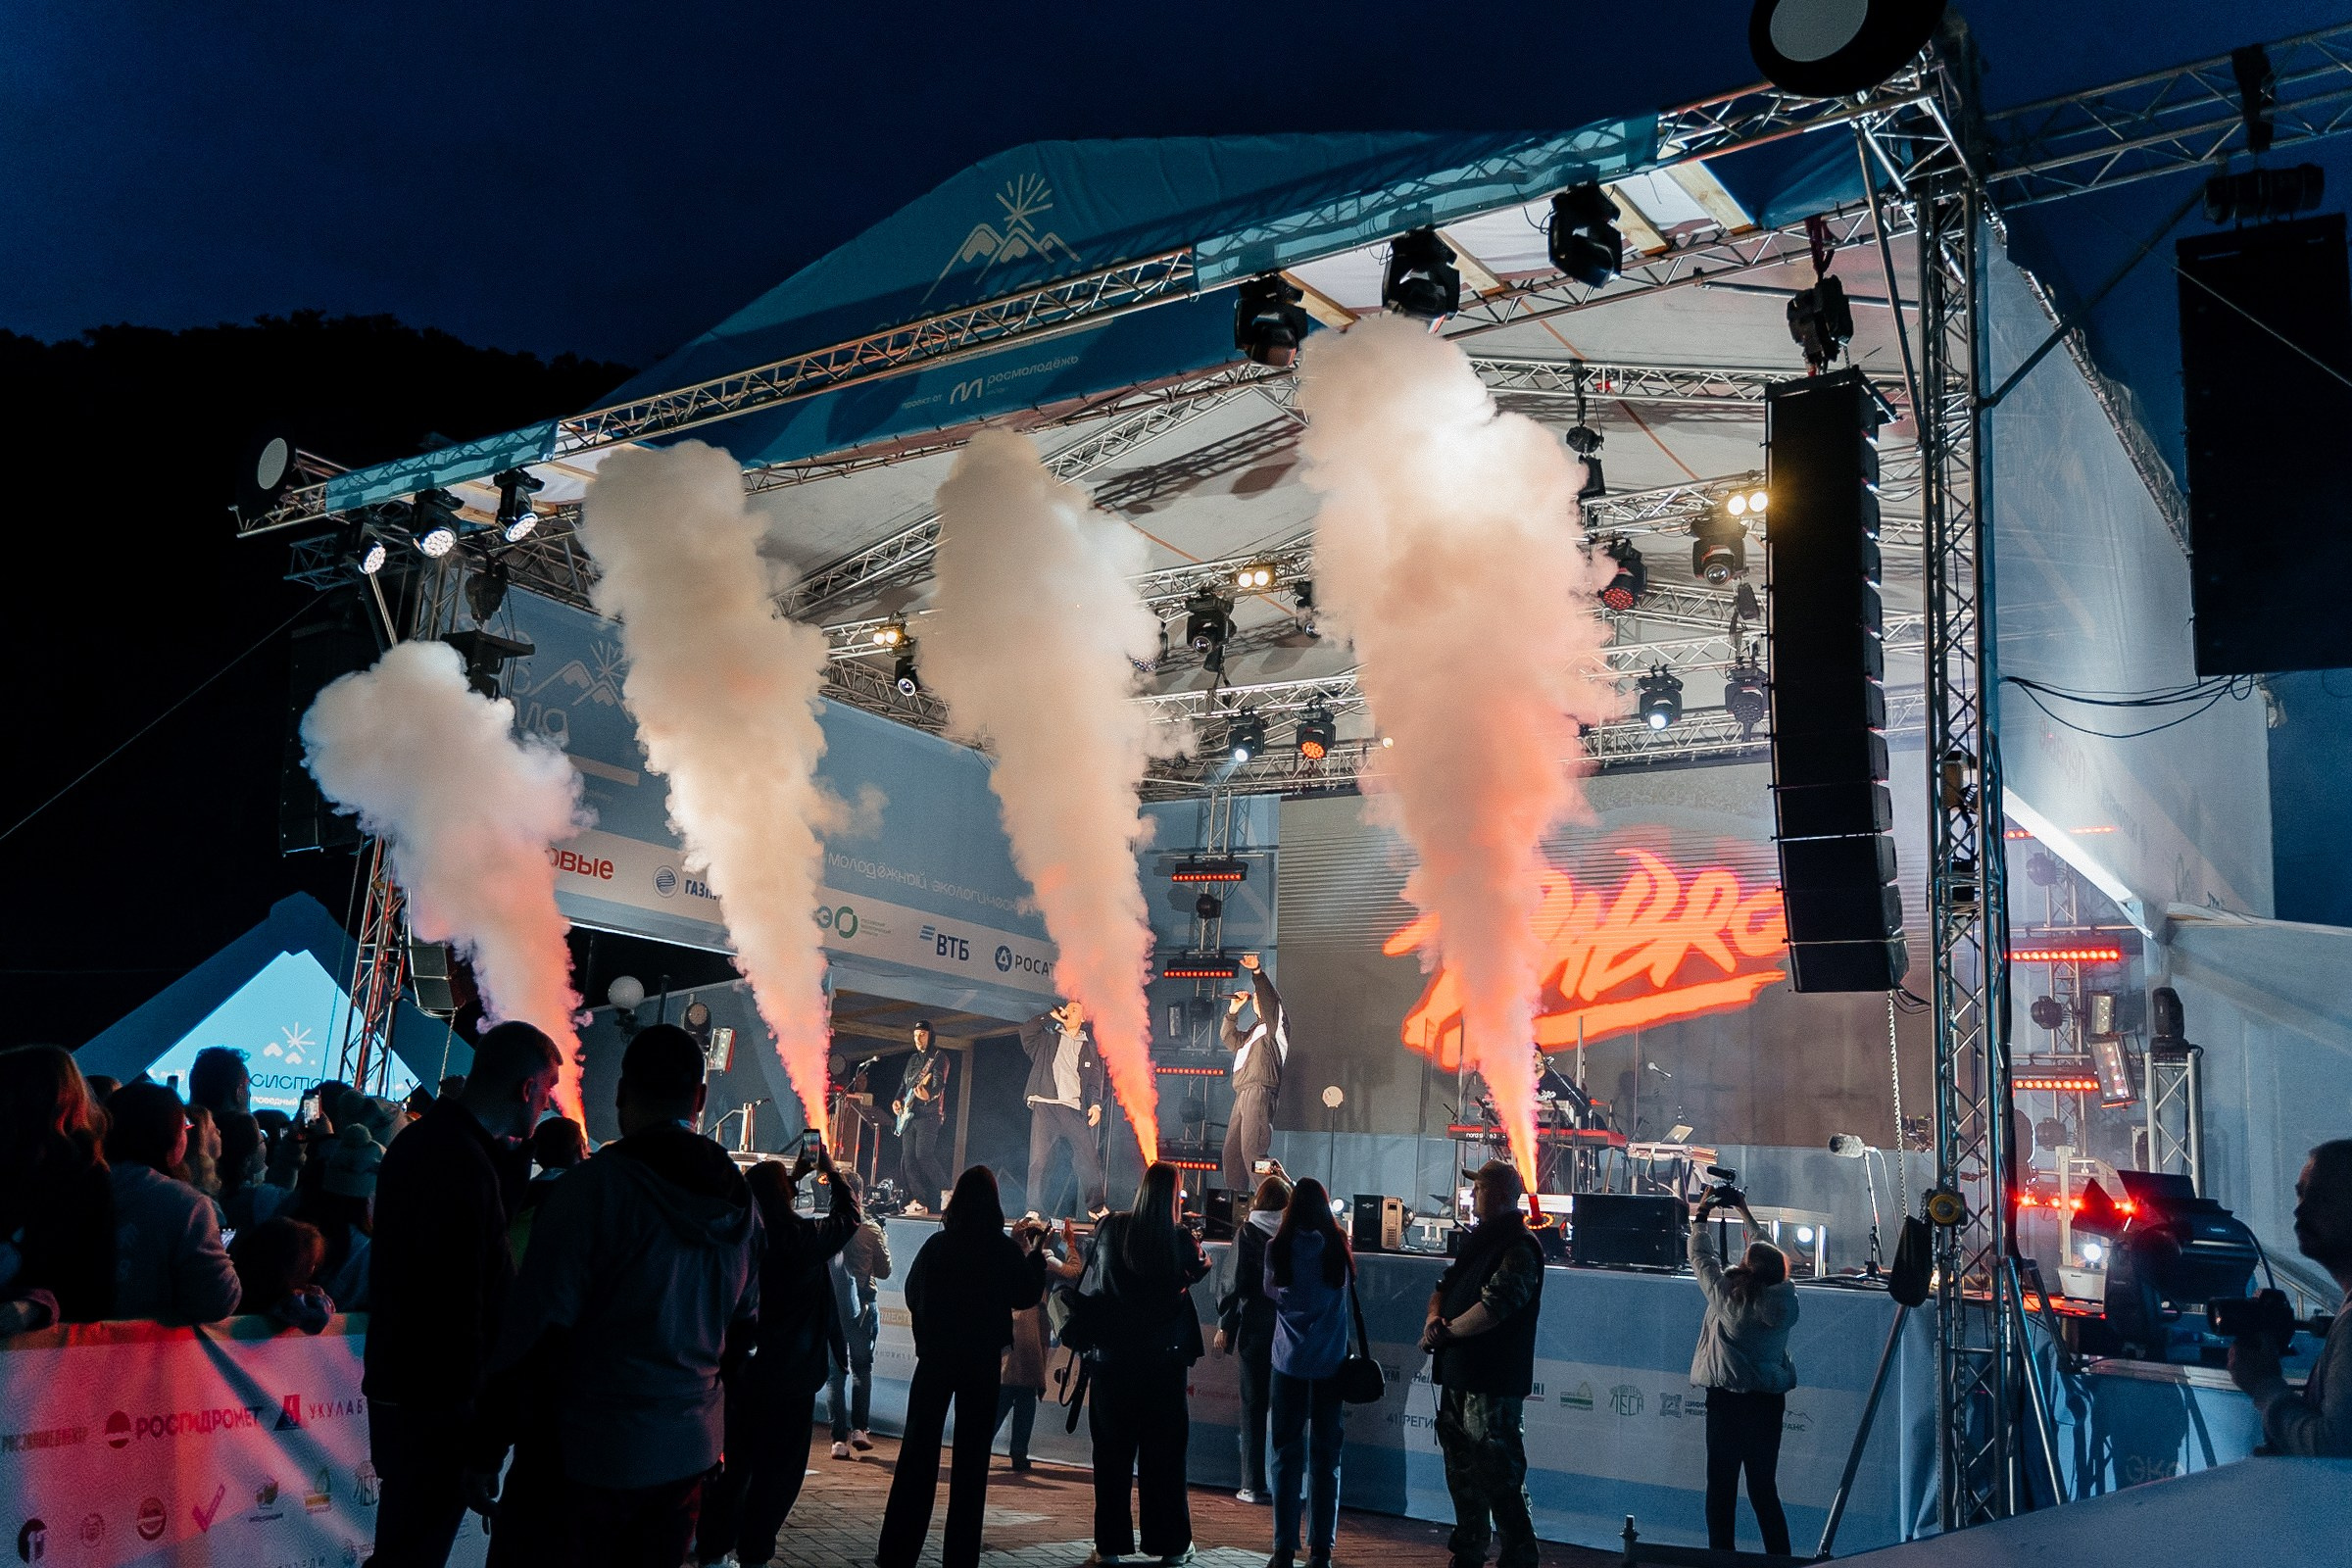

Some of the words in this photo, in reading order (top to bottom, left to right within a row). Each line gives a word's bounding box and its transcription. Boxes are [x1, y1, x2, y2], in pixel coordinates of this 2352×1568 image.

[987, 355, 1079, 386] росмолодёжь
[936, 933, 970, 961] ВТБ
[135, 1406, 263, 1440] РОСГИДРОМЕТ
[1403, 1414, 1434, 1429] РЕГИ
